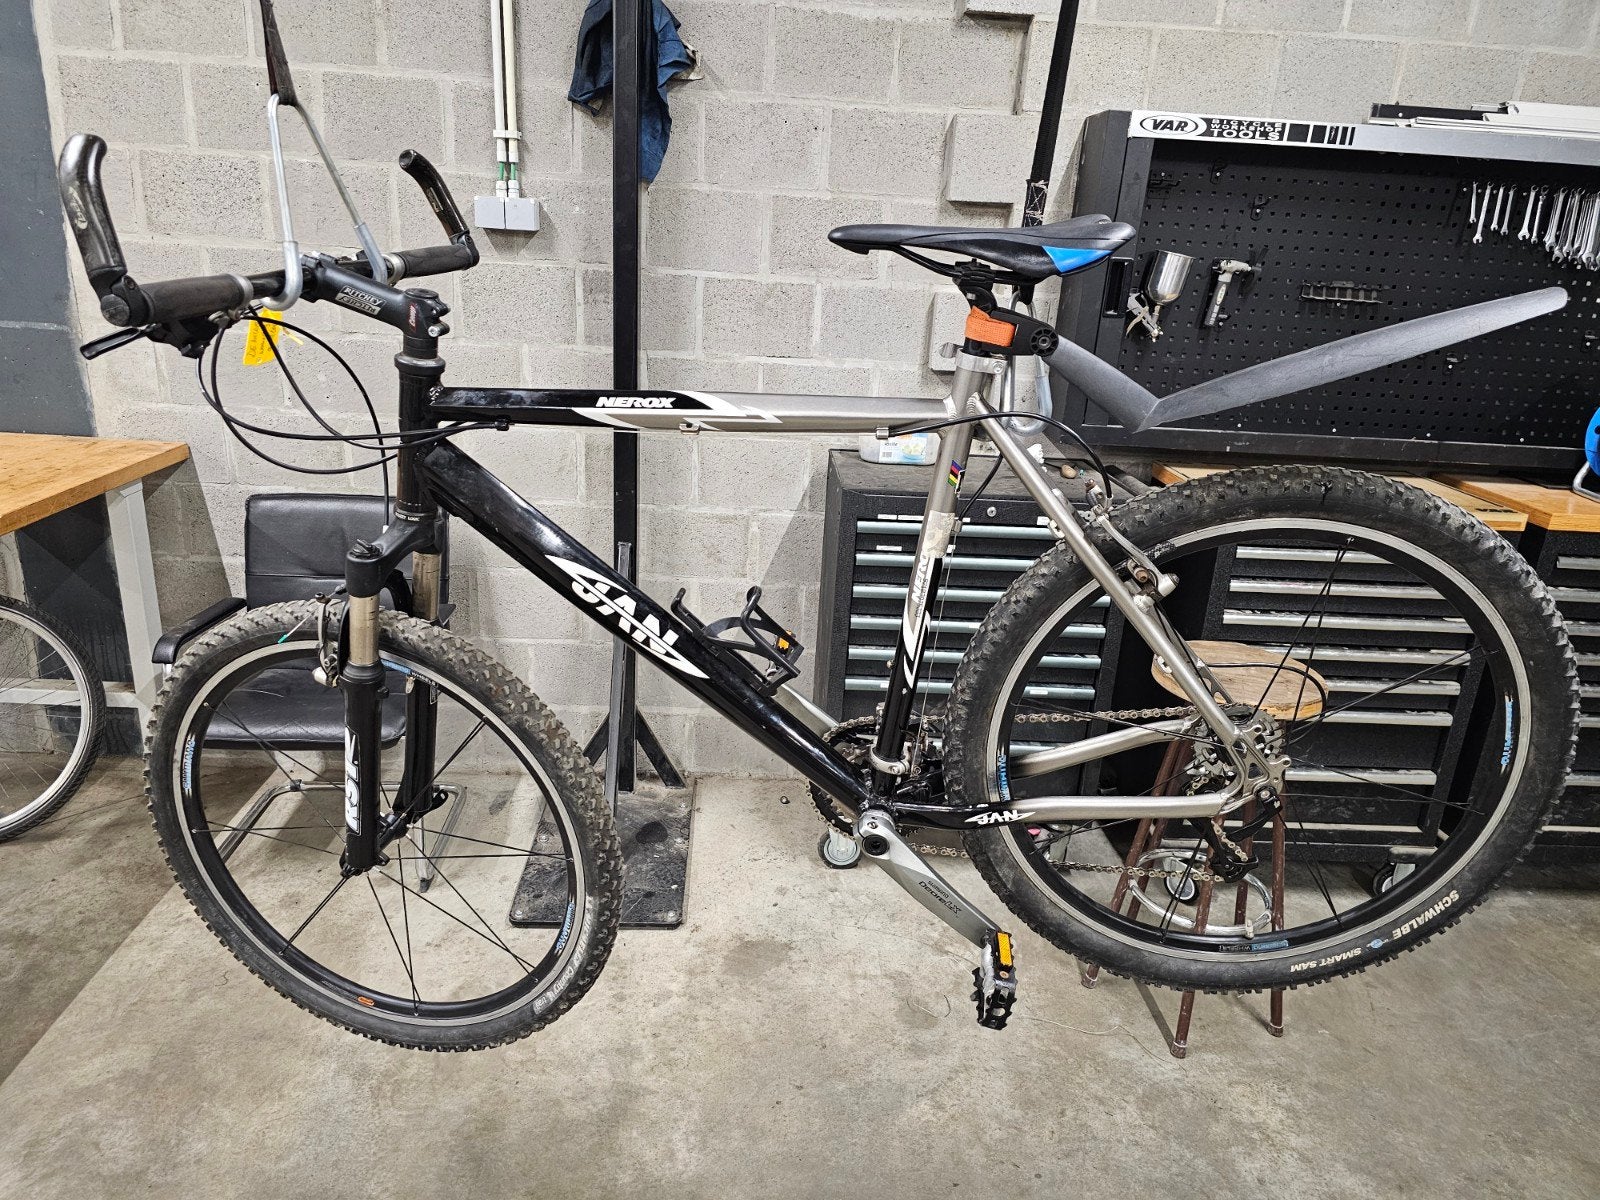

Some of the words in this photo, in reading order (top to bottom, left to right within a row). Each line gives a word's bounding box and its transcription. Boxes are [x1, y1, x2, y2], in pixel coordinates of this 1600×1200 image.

[1152, 119, 1189, 131] VAR
[1210, 123, 1283, 132] WORKSHOP
[1212, 118, 1283, 128] BICYCLE
[1210, 128, 1280, 141] TOOLS
[344, 287, 383, 306] RITCHEY
[595, 396, 677, 409] NEROX
[1392, 889, 1460, 939] SCHWALBE
[1326, 946, 1363, 967] SMART
[1290, 960, 1325, 973] SAM
